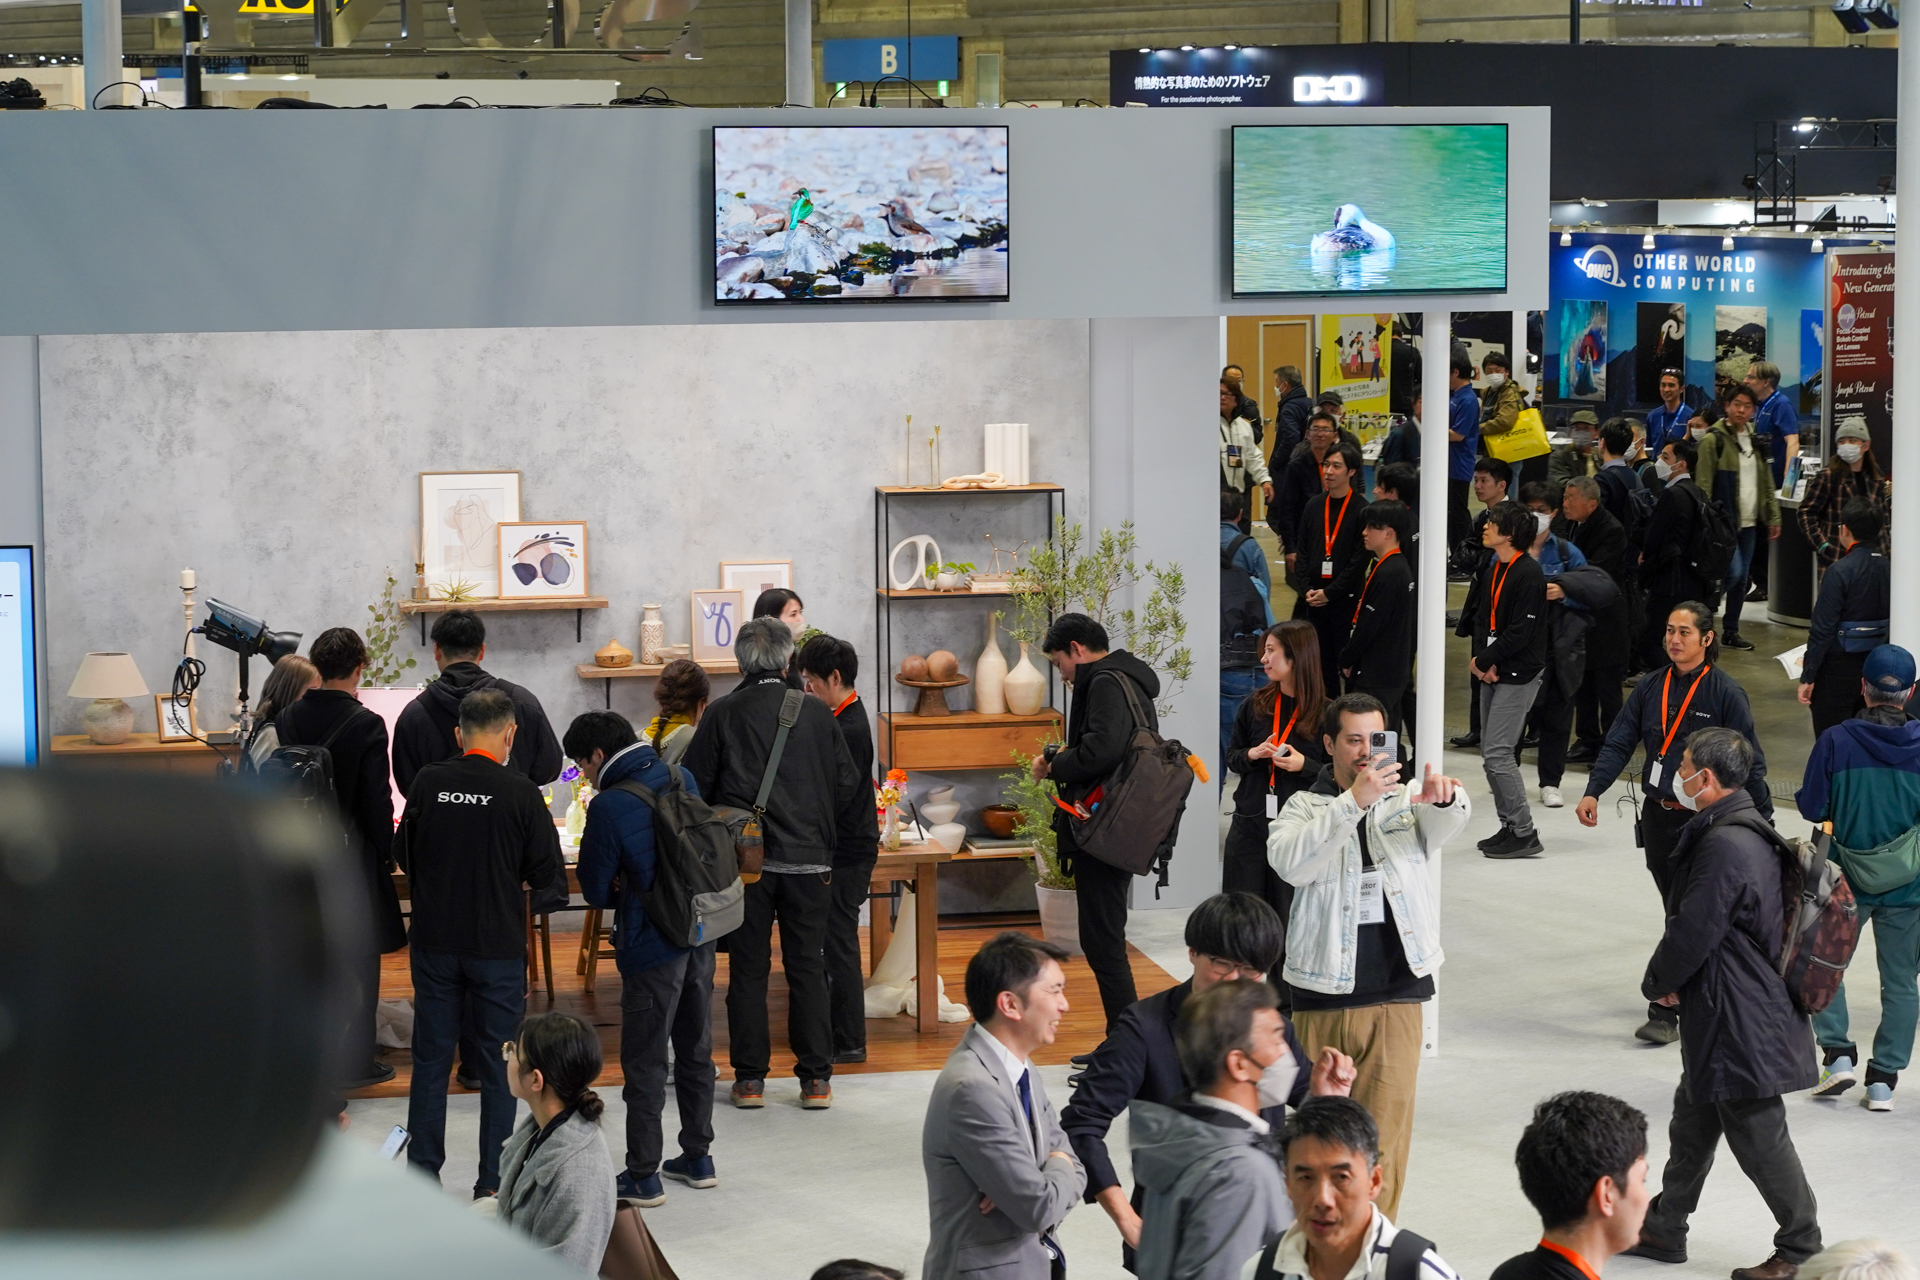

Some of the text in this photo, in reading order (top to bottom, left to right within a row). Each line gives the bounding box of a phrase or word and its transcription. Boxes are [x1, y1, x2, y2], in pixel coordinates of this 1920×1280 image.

[881, 44, 897, 74] B
[1134, 75, 1270, 90] 情熱的な写真家のためのソフトウェア
[1180, 96, 1205, 104] passionate
[1206, 95, 1242, 104] photographer.
[1633, 253, 1756, 273] OTHER WORLD
[1586, 263, 1612, 279] OWC
[1837, 264, 1882, 279] Introducing
[1633, 274, 1755, 293] COMPUTING
[1843, 280, 1895, 294] New Generat
[1851, 334, 1869, 342] Control
[1844, 343, 1861, 351] Lenses
[1834, 380, 1876, 398] Joseph Petzval
[1834, 402, 1846, 410] Cine
[216, 608, 243, 624] NANLITE
[437, 791, 493, 806] SONY
[1361, 882, 1376, 890] sitor
